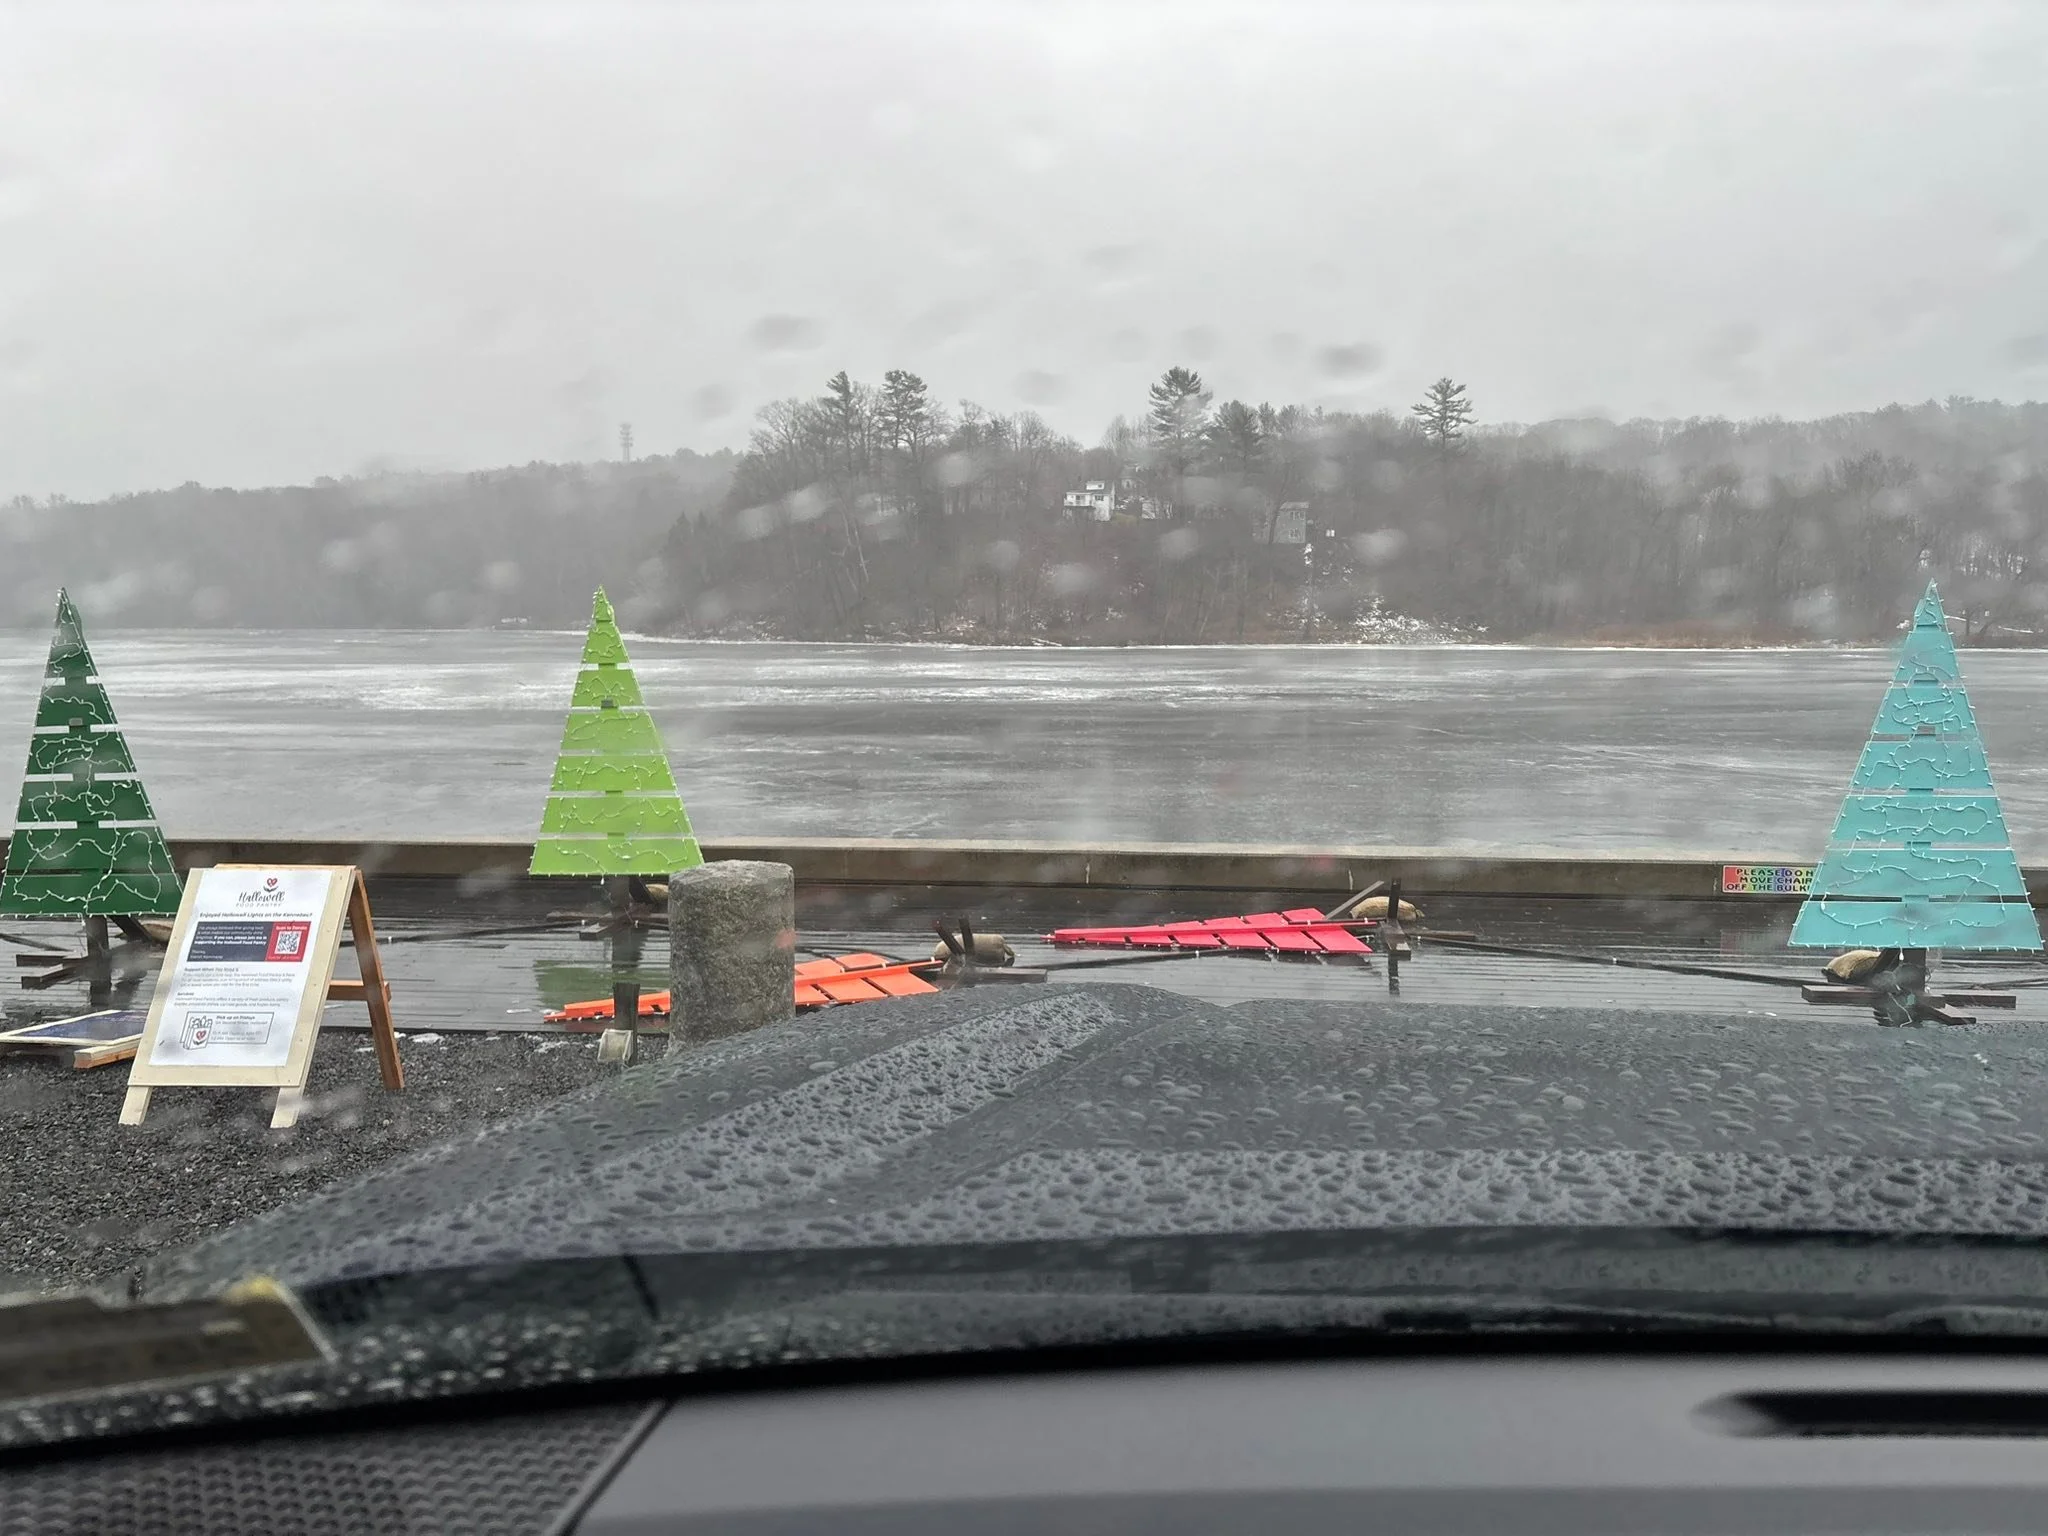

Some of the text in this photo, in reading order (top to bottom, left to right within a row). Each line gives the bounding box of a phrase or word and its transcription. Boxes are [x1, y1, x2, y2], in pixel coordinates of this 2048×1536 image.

[1736, 868, 1780, 876] PLEASE
[1740, 876, 1813, 885] MOVE CHAIR
[1752, 883, 1772, 891] THE
[238, 891, 286, 903] Hallowell
